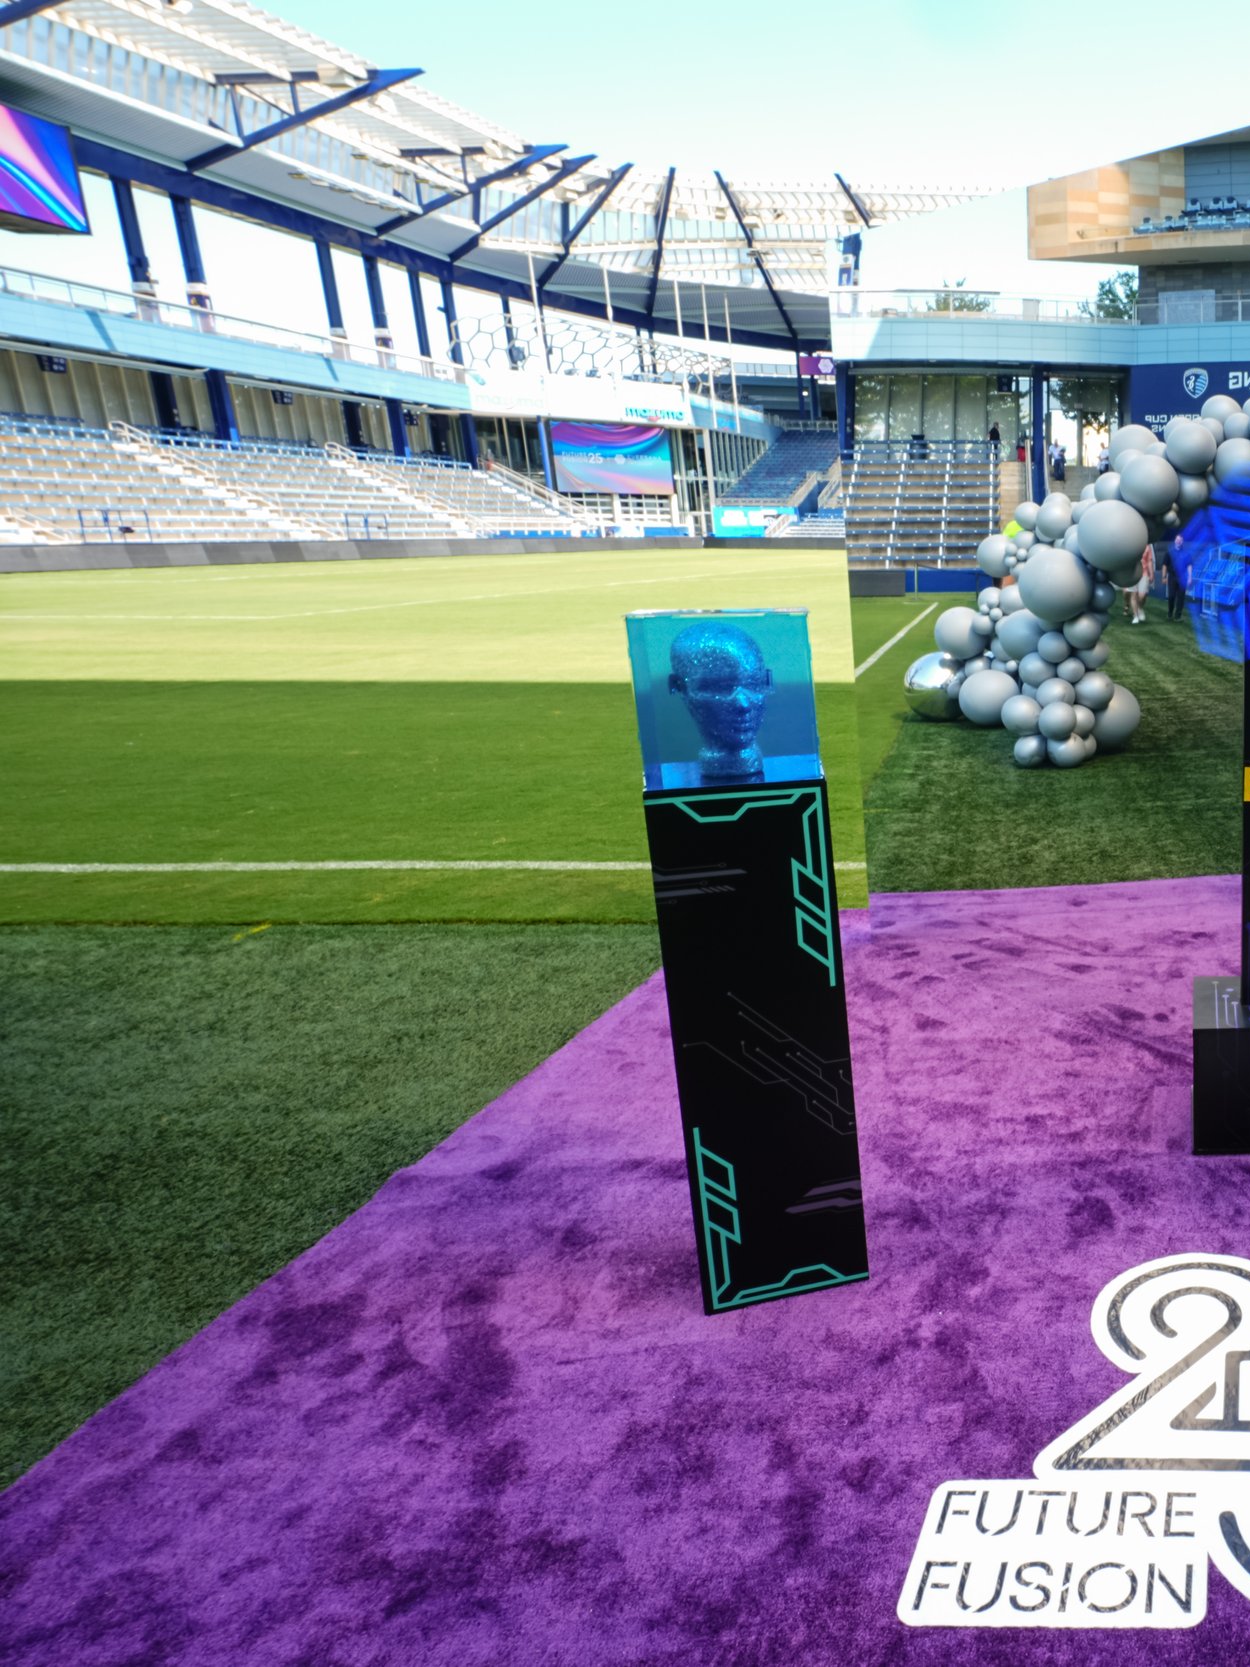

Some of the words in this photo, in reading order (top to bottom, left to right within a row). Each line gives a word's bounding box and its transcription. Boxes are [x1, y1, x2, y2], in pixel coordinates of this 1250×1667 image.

[588, 452, 603, 464] 25
[934, 1490, 1197, 1538] FUTURE
[911, 1561, 1194, 1615] FUSION
